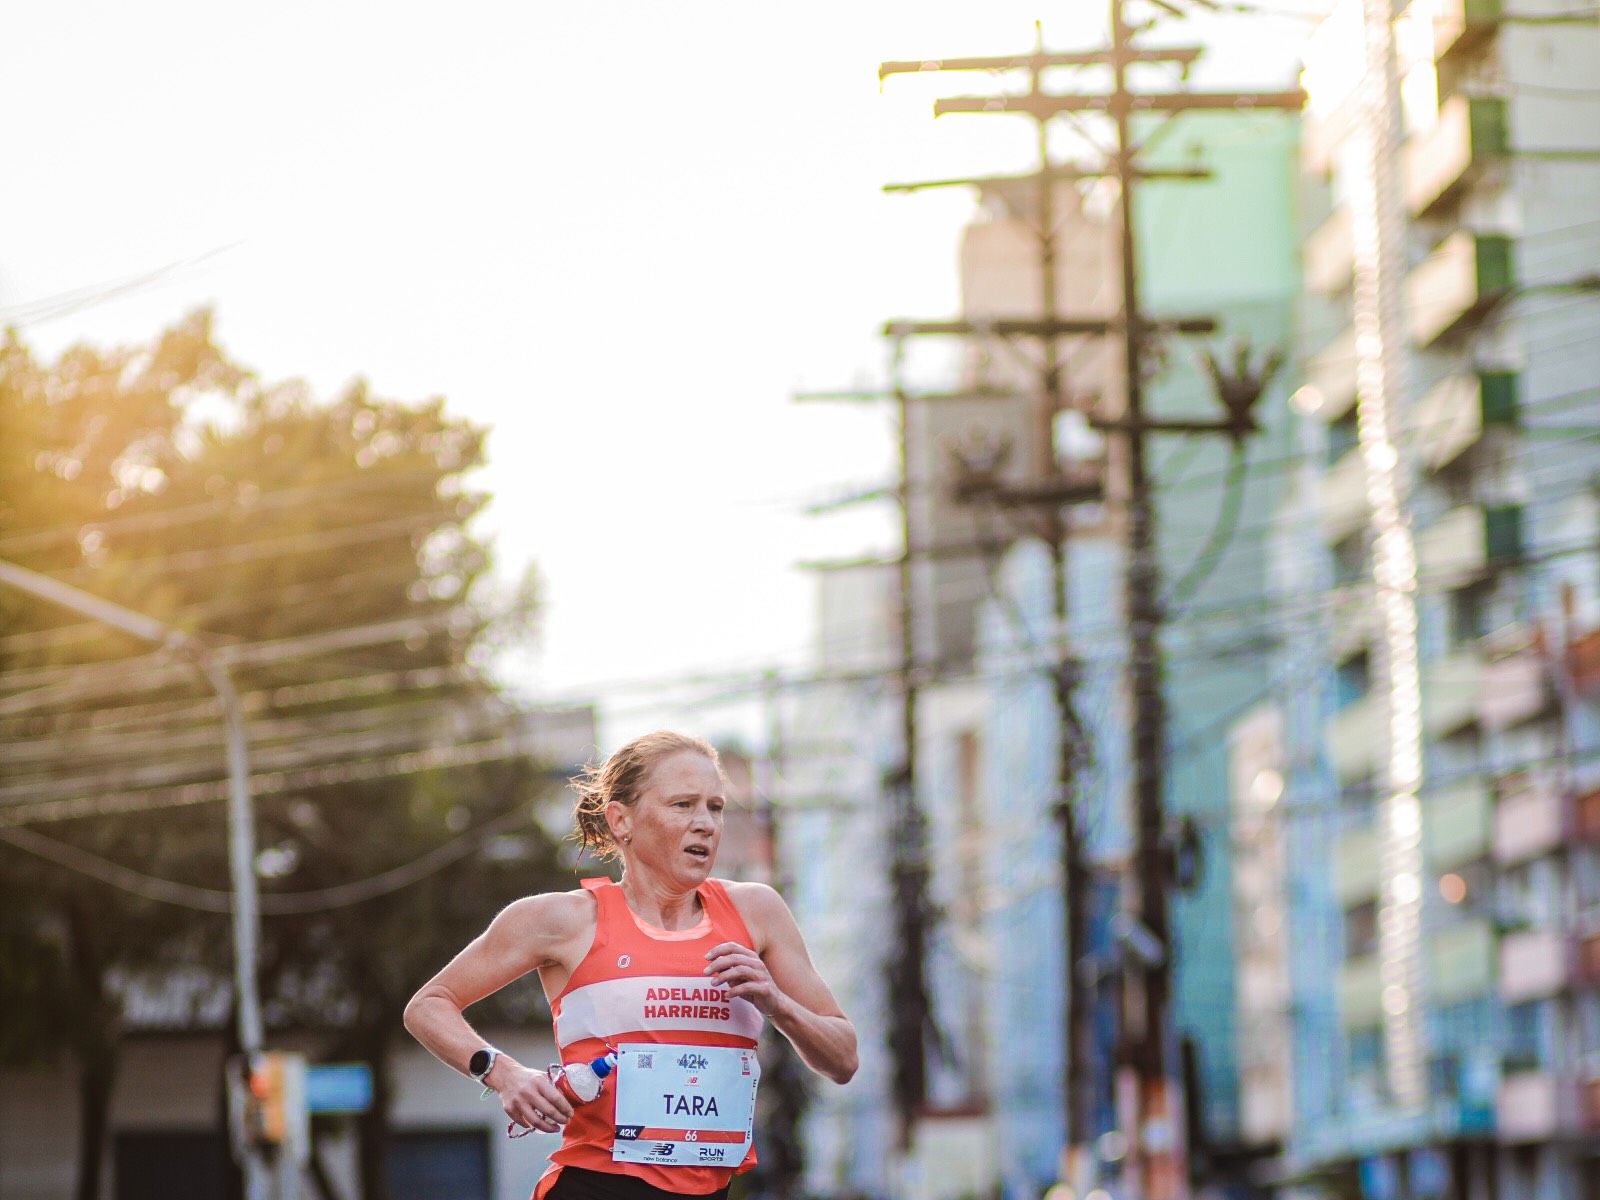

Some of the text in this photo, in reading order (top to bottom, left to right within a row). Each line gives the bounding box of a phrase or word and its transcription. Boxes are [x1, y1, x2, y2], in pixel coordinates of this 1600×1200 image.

[645, 988, 730, 1003] ADELAIDE
[644, 1005, 730, 1021] HARRIERS
[663, 1094, 719, 1117] TARA
[619, 1128, 637, 1138] 42K
[684, 1131, 698, 1142] 66
[699, 1148, 724, 1157] RUN
